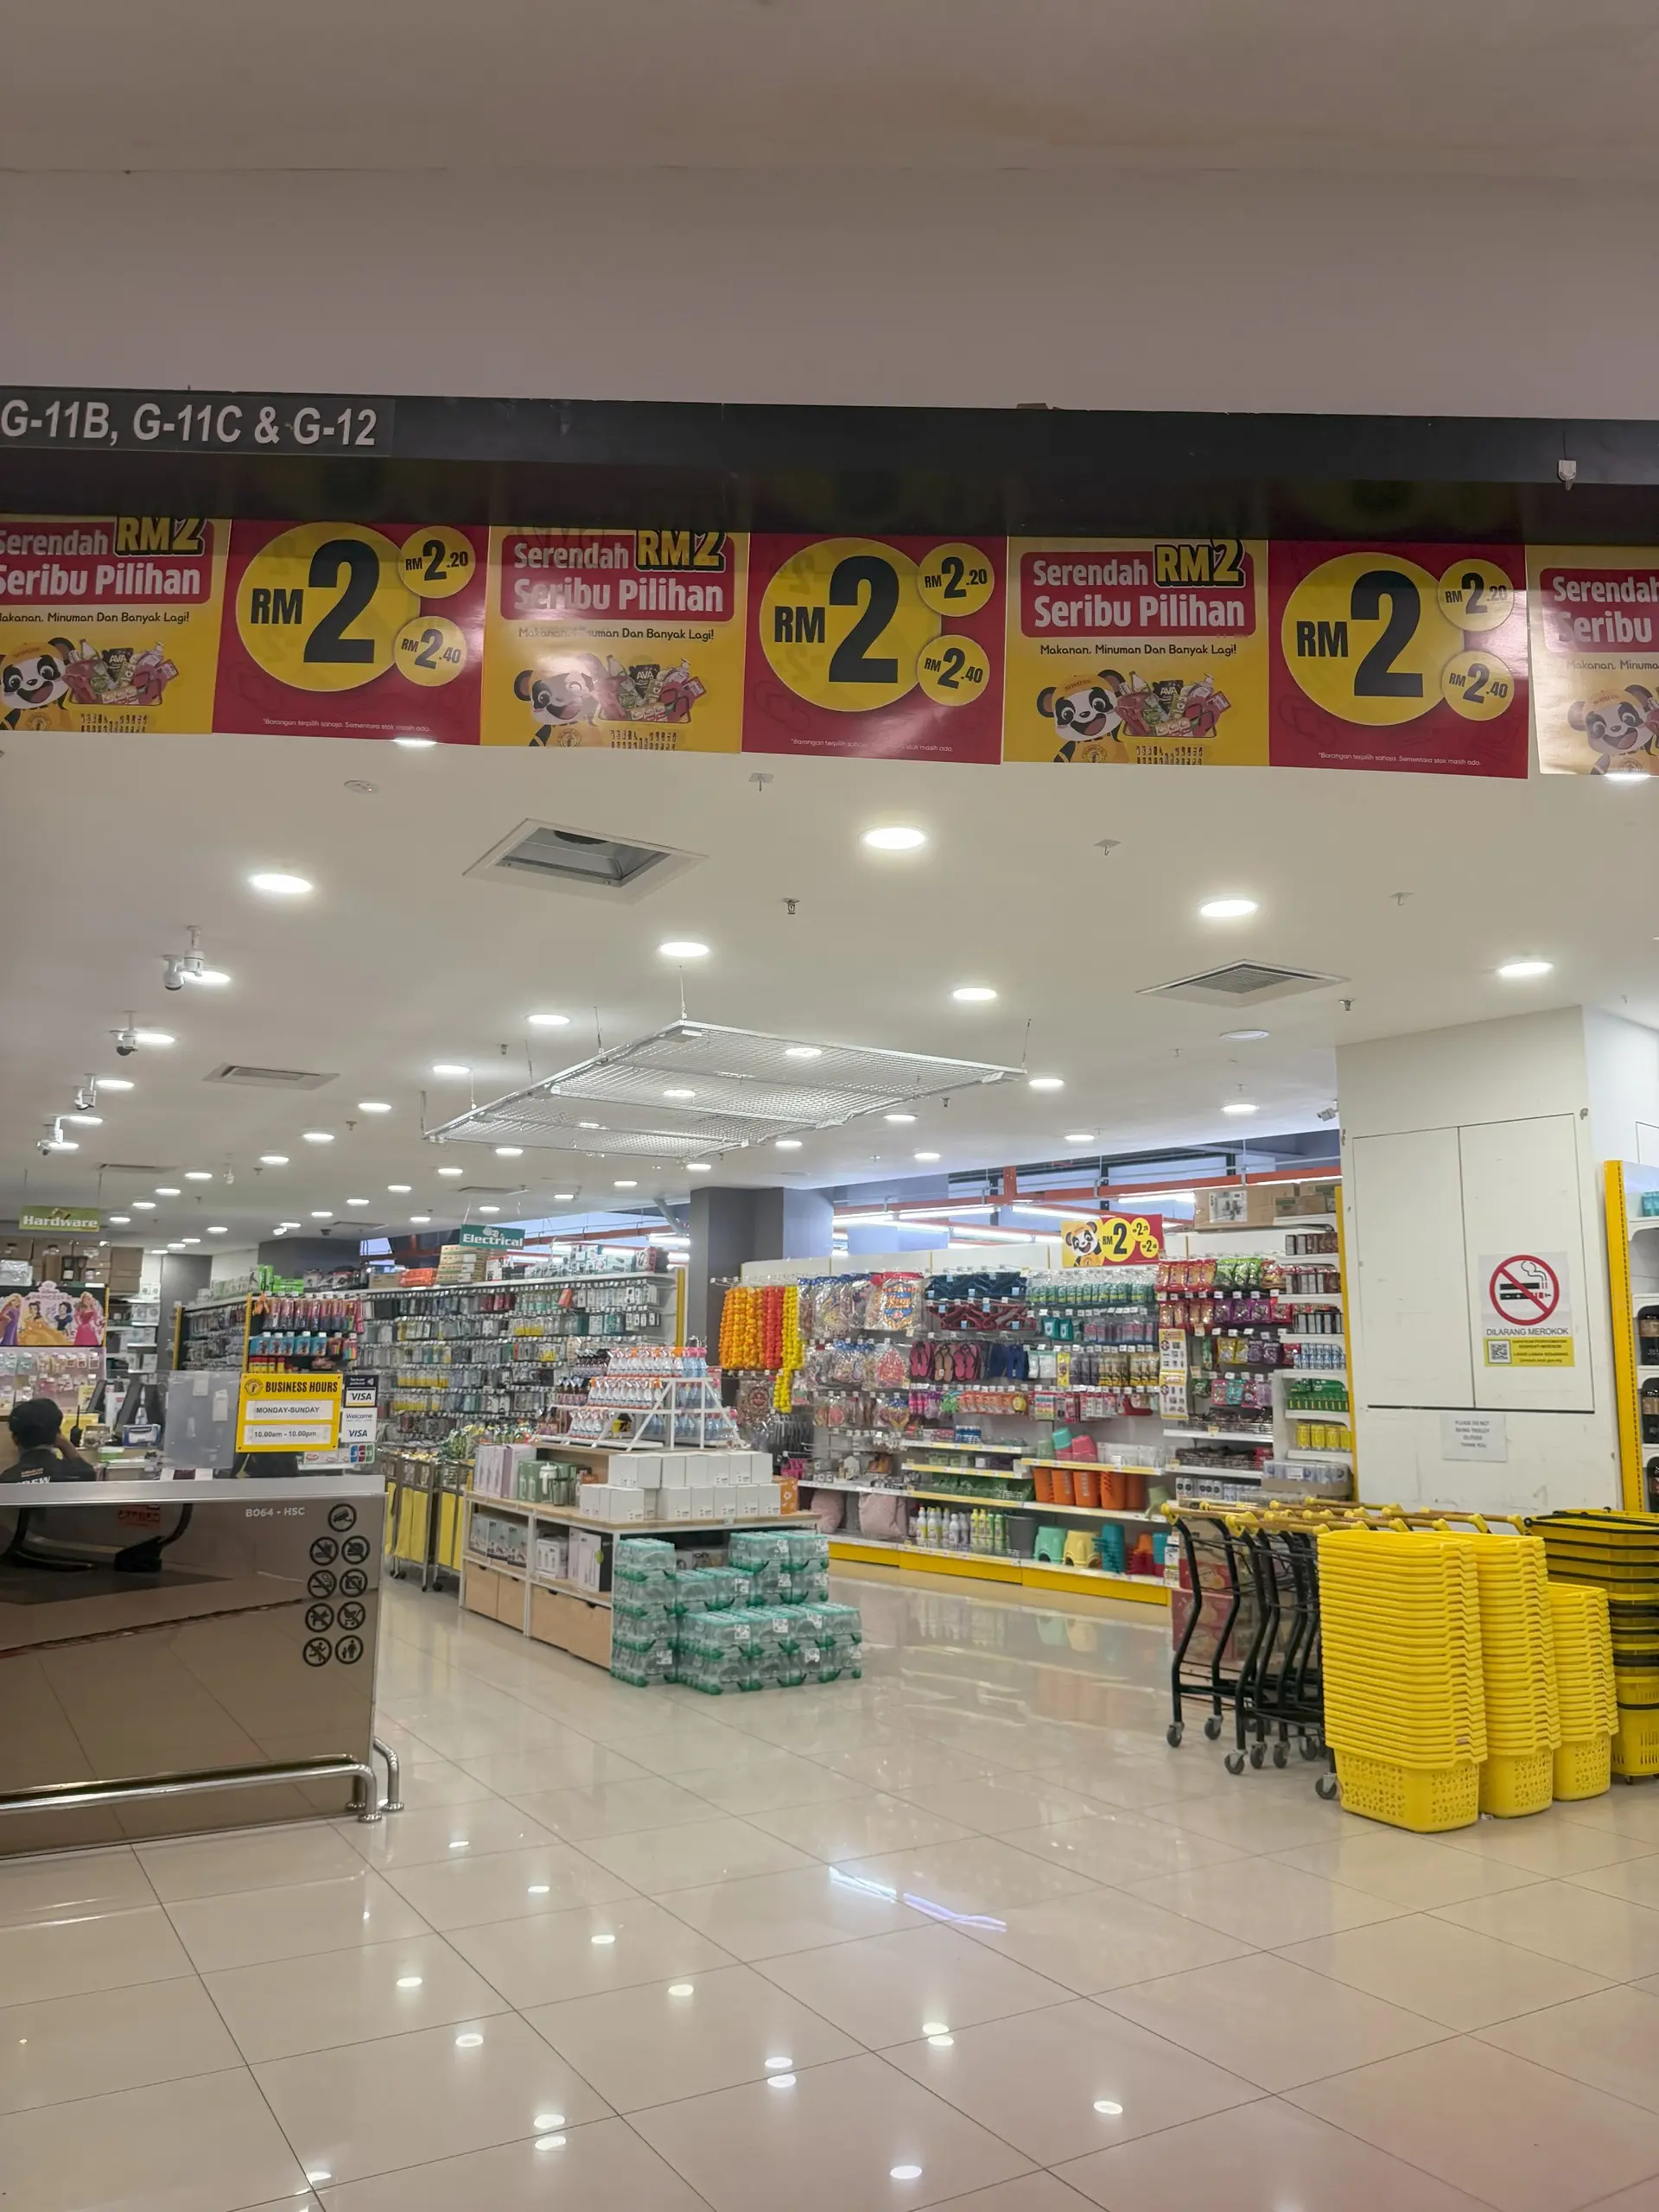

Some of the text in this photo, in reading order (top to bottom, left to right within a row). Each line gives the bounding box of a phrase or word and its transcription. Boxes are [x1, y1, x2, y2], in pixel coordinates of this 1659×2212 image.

[1, 399, 377, 446] G-11B, G-11C & G-12
[116, 518, 204, 554] RM2
[514, 530, 725, 570] Serendah RM2
[1033, 540, 1244, 586] Serendah RM2
[95, 563, 200, 594] Pilihan
[1553, 575, 1659, 603] Serendah
[514, 577, 723, 612] Seribu Pilihan
[48, 612, 93, 622] Minuman
[97, 612, 118, 622] Dan
[121, 612, 161, 624] Banyak
[164, 612, 189, 624] Lagi!
[1034, 594, 1244, 627] Seribu Pilihan
[622, 628, 644, 639] Dan
[647, 629, 686, 641] Banyak
[689, 629, 715, 642] Lagi!
[1556, 611, 1652, 643] Seribu
[1040, 644, 1236, 657] Makanan, Minuman Dan Banyak Lagi!
[1620, 659, 1659, 670] Minuma
[22, 1214, 99, 1229] Hardware
[462, 1233, 524, 1248] Electrical
[265, 1382, 308, 1393] BUSINESS
[309, 1382, 338, 1393] HOURS
[351, 1392, 372, 1401] VISA
[284, 1507, 305, 1516] HSC
